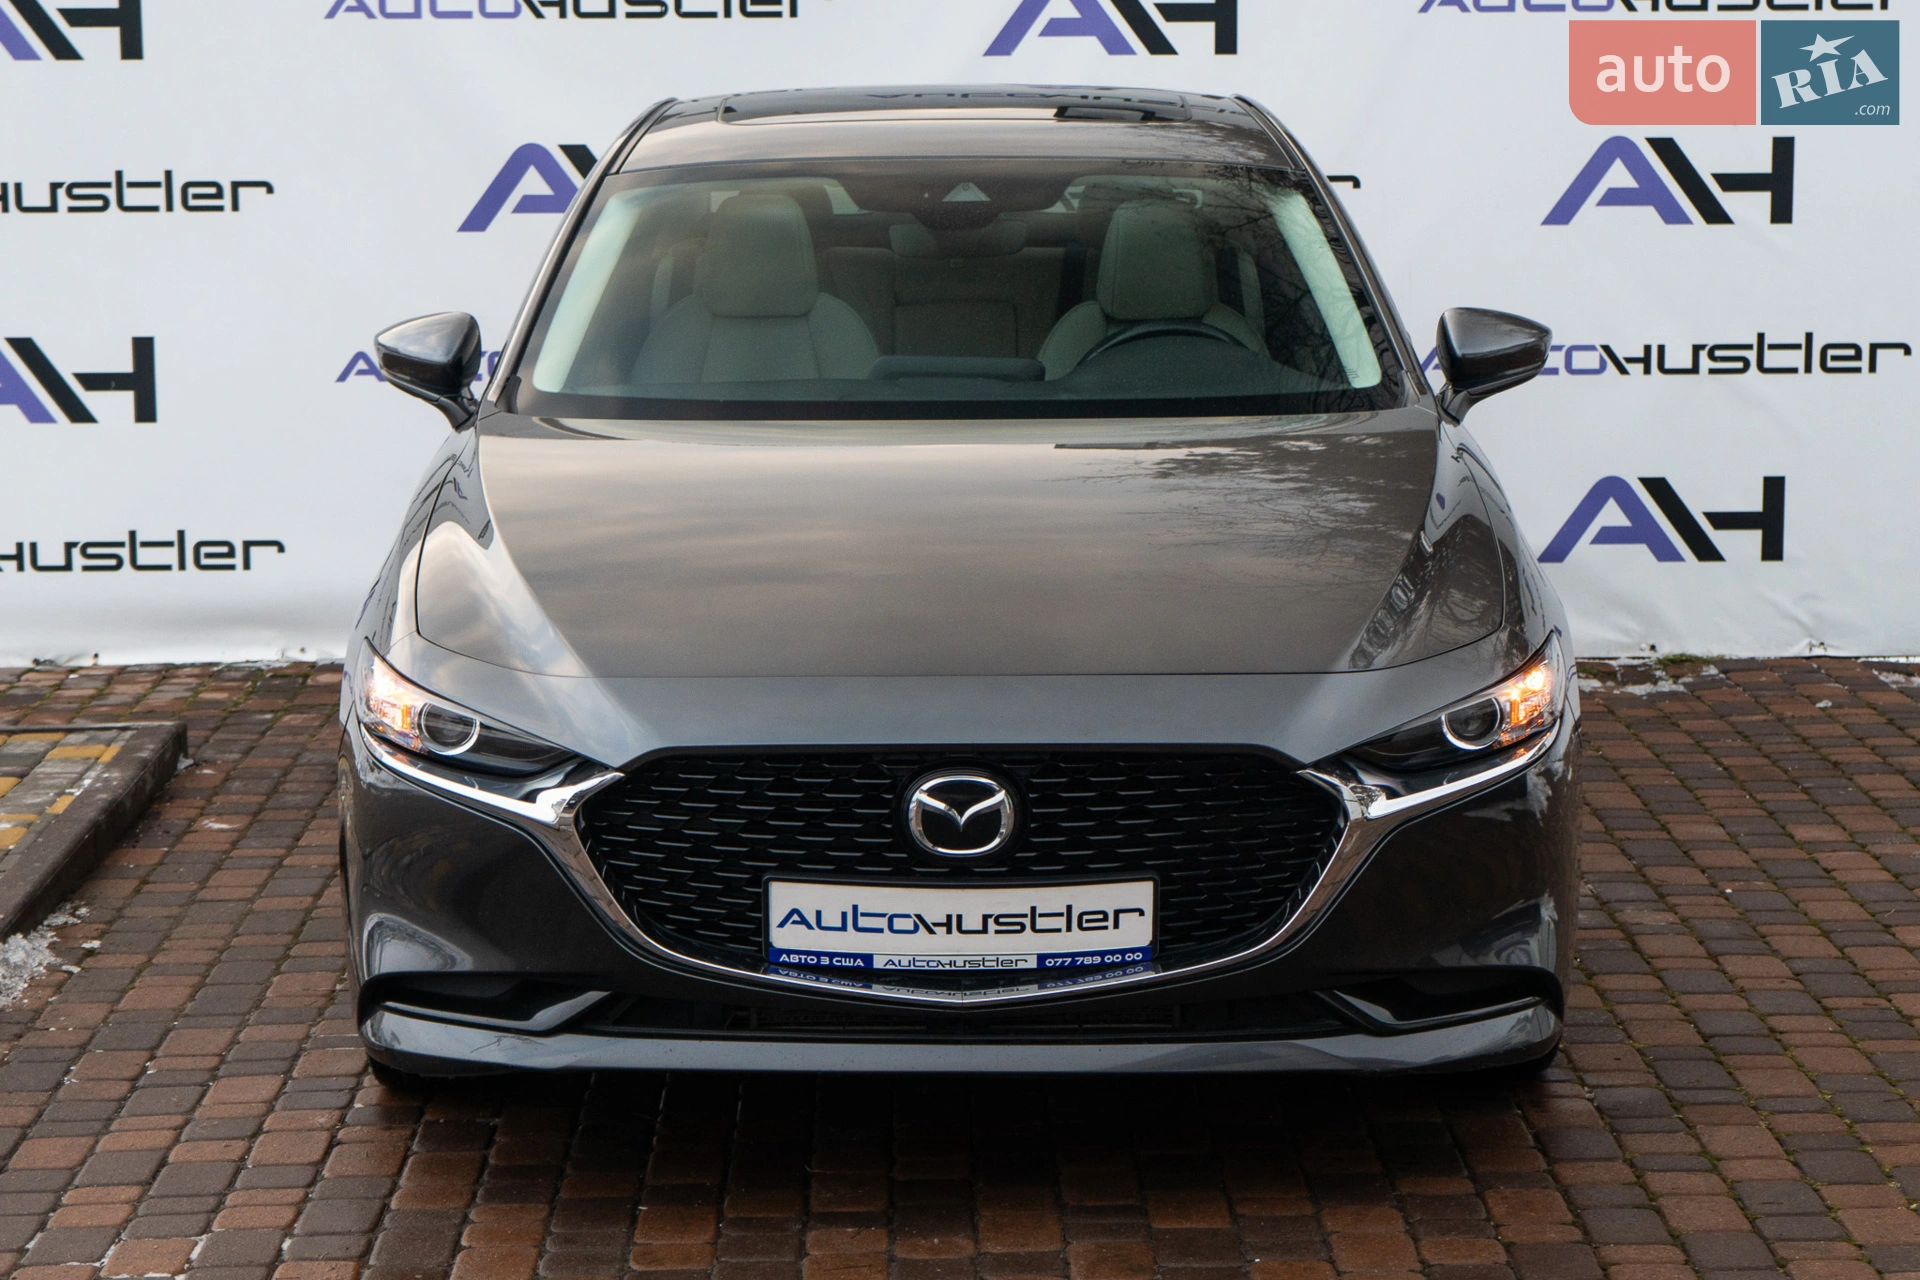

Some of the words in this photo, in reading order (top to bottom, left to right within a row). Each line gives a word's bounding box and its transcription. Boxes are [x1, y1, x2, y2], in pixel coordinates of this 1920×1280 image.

[0, 0, 144, 60] H
[457, 143, 600, 232] A
[1540, 135, 1795, 226] AH
[1537, 475, 1786, 563] AH
[779, 953, 817, 964] АВТО
[833, 957, 865, 966] США
[1045, 957, 1072, 967] 077
[1075, 956, 1102, 965] 789
[1104, 954, 1122, 963] 00
[1125, 952, 1143, 961] 00
